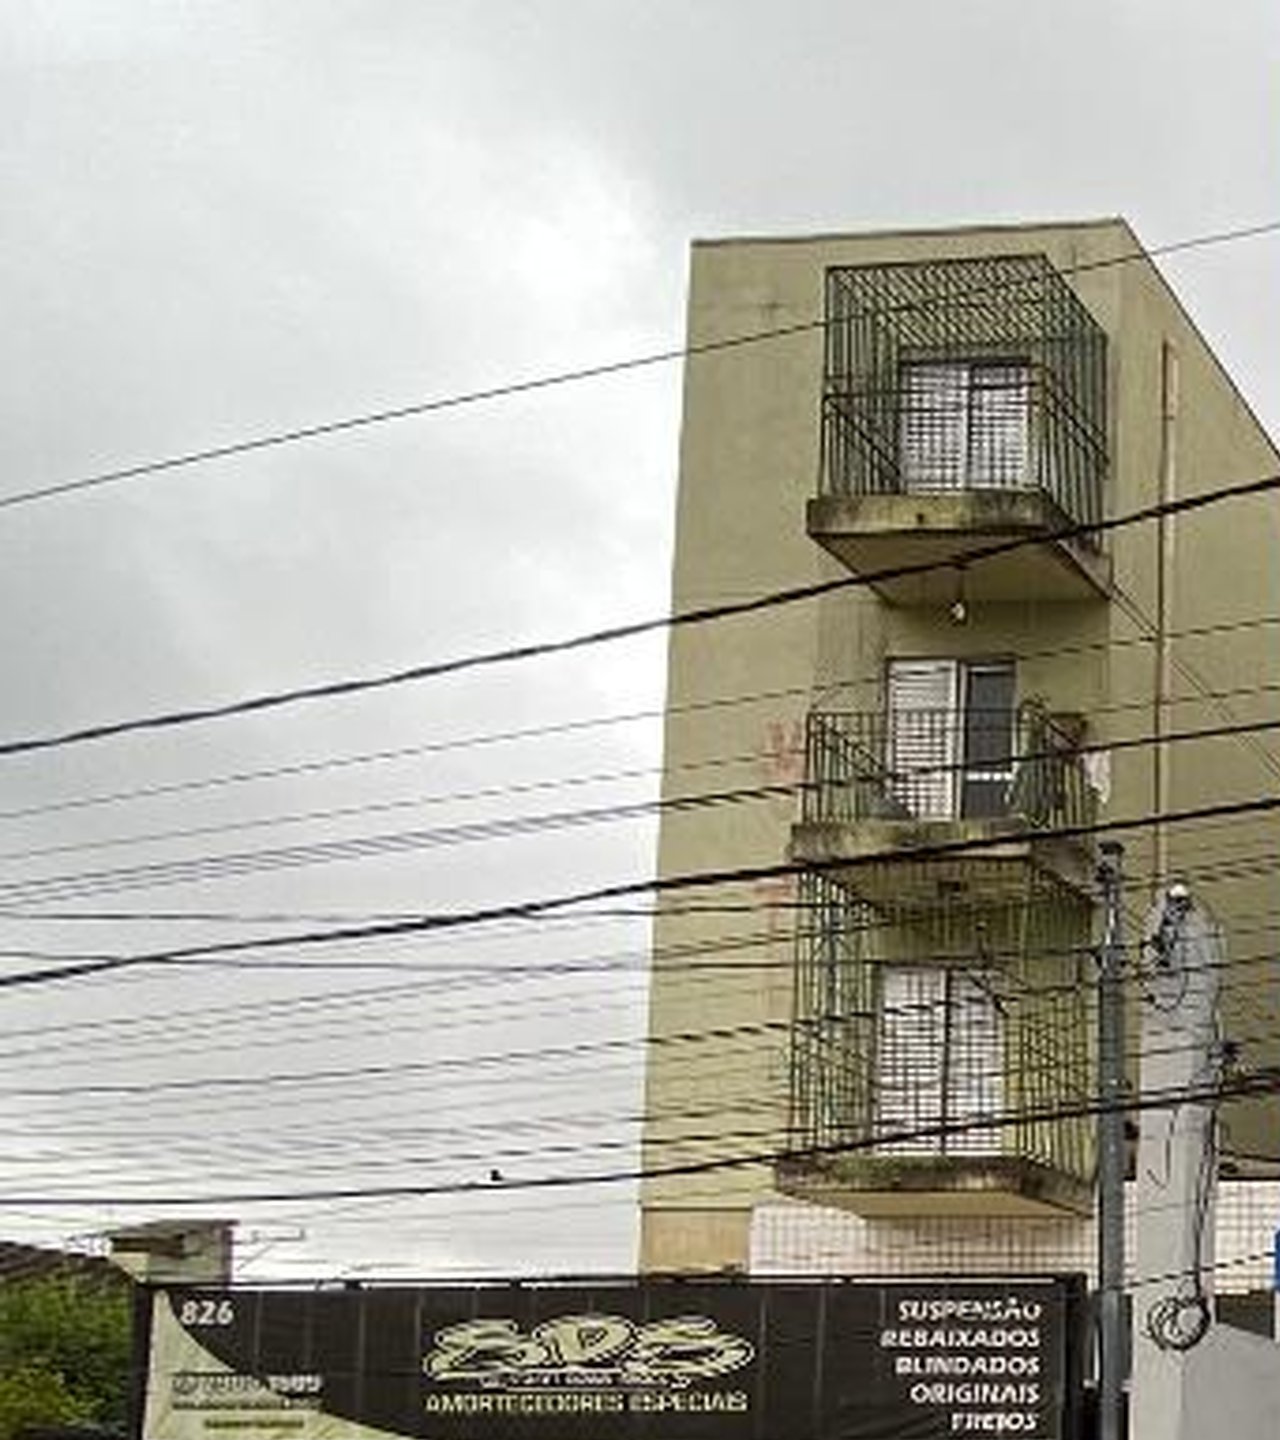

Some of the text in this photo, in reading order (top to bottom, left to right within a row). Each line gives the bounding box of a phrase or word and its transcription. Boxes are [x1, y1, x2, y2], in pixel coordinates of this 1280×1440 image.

[180, 1301, 234, 1325] 826
[899, 1297, 1042, 1321] SUSPENSÃO
[880, 1329, 1041, 1347] REBAIXADOS
[895, 1356, 1041, 1374] BLINDADOS
[910, 1383, 1040, 1404] ORIGINAIS
